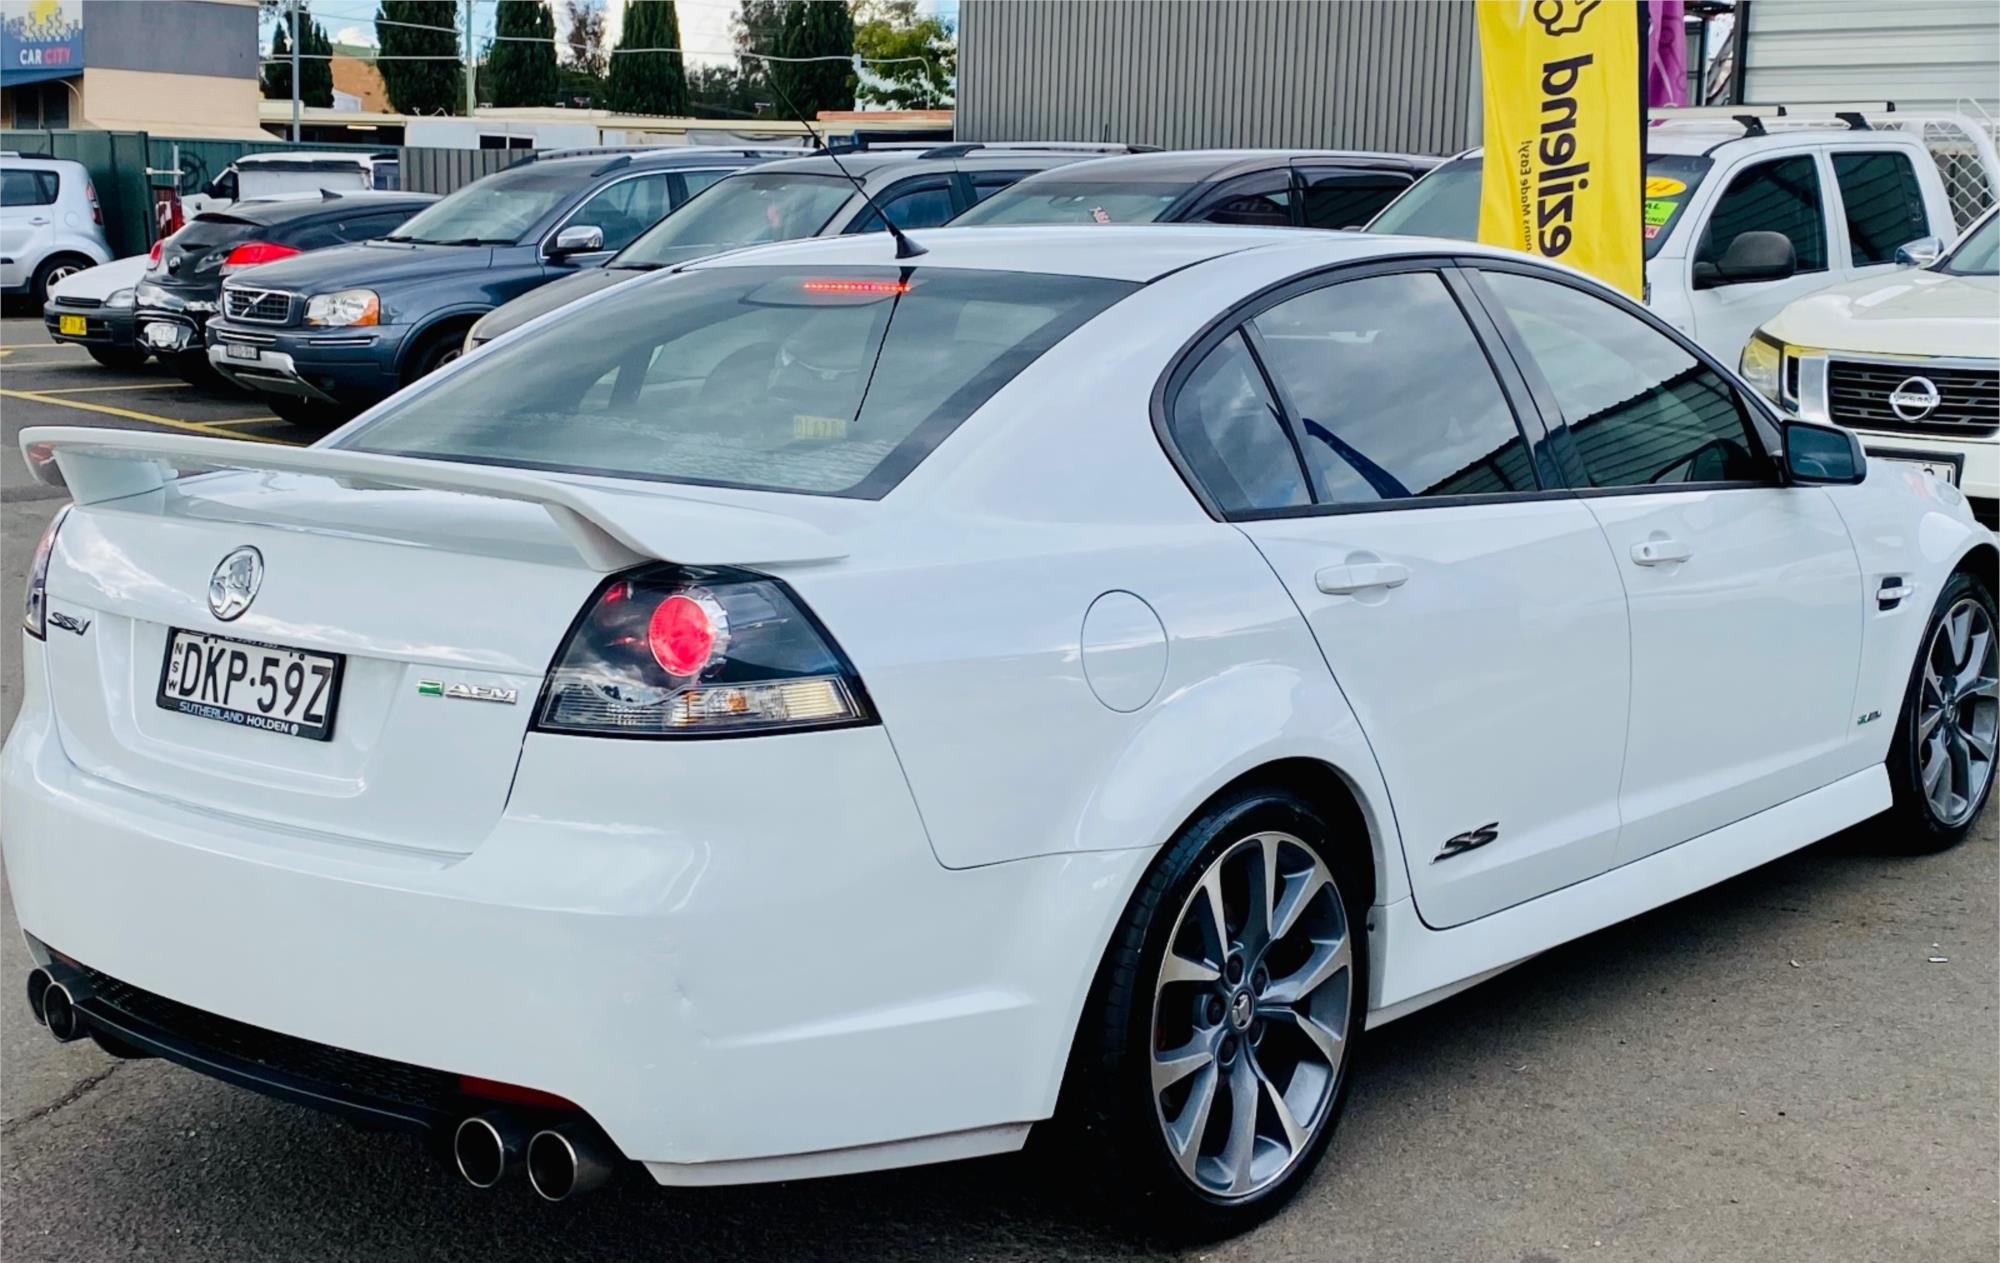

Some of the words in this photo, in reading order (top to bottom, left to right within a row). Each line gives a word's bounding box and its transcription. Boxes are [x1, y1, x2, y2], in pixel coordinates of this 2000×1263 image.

[20, 48, 42, 65] CAR
[44, 47, 71, 65] CITY
[179, 701, 245, 724] SUTHERLAND
[246, 715, 290, 733] HOLDEN
[1429, 821, 1500, 865] SS
